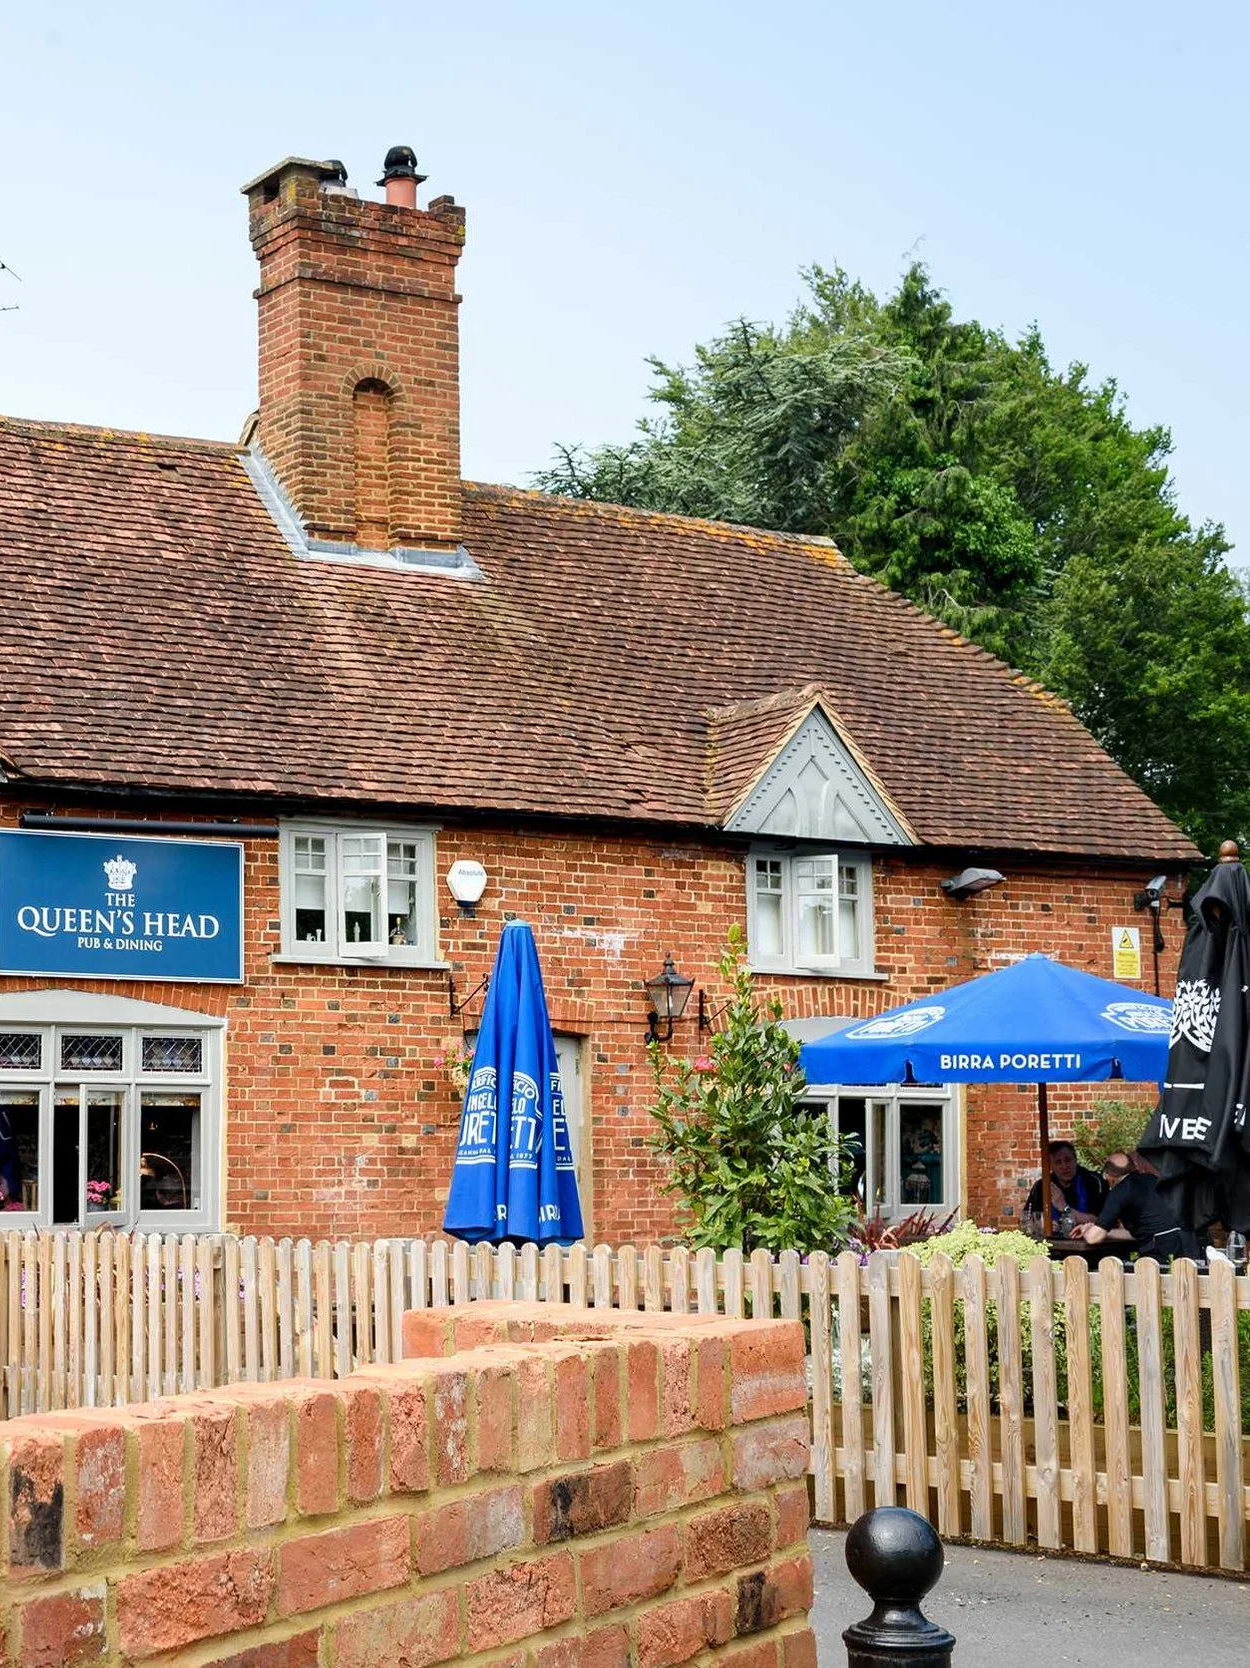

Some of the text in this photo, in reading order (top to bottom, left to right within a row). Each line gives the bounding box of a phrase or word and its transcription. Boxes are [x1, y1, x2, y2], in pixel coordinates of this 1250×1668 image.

[105, 892, 135, 907] THE
[17, 906, 219, 939] QUEEN'S HEAD
[78, 937, 163, 951] PUB & DINING
[940, 1053, 1081, 1069] BIRRA PORETTI
